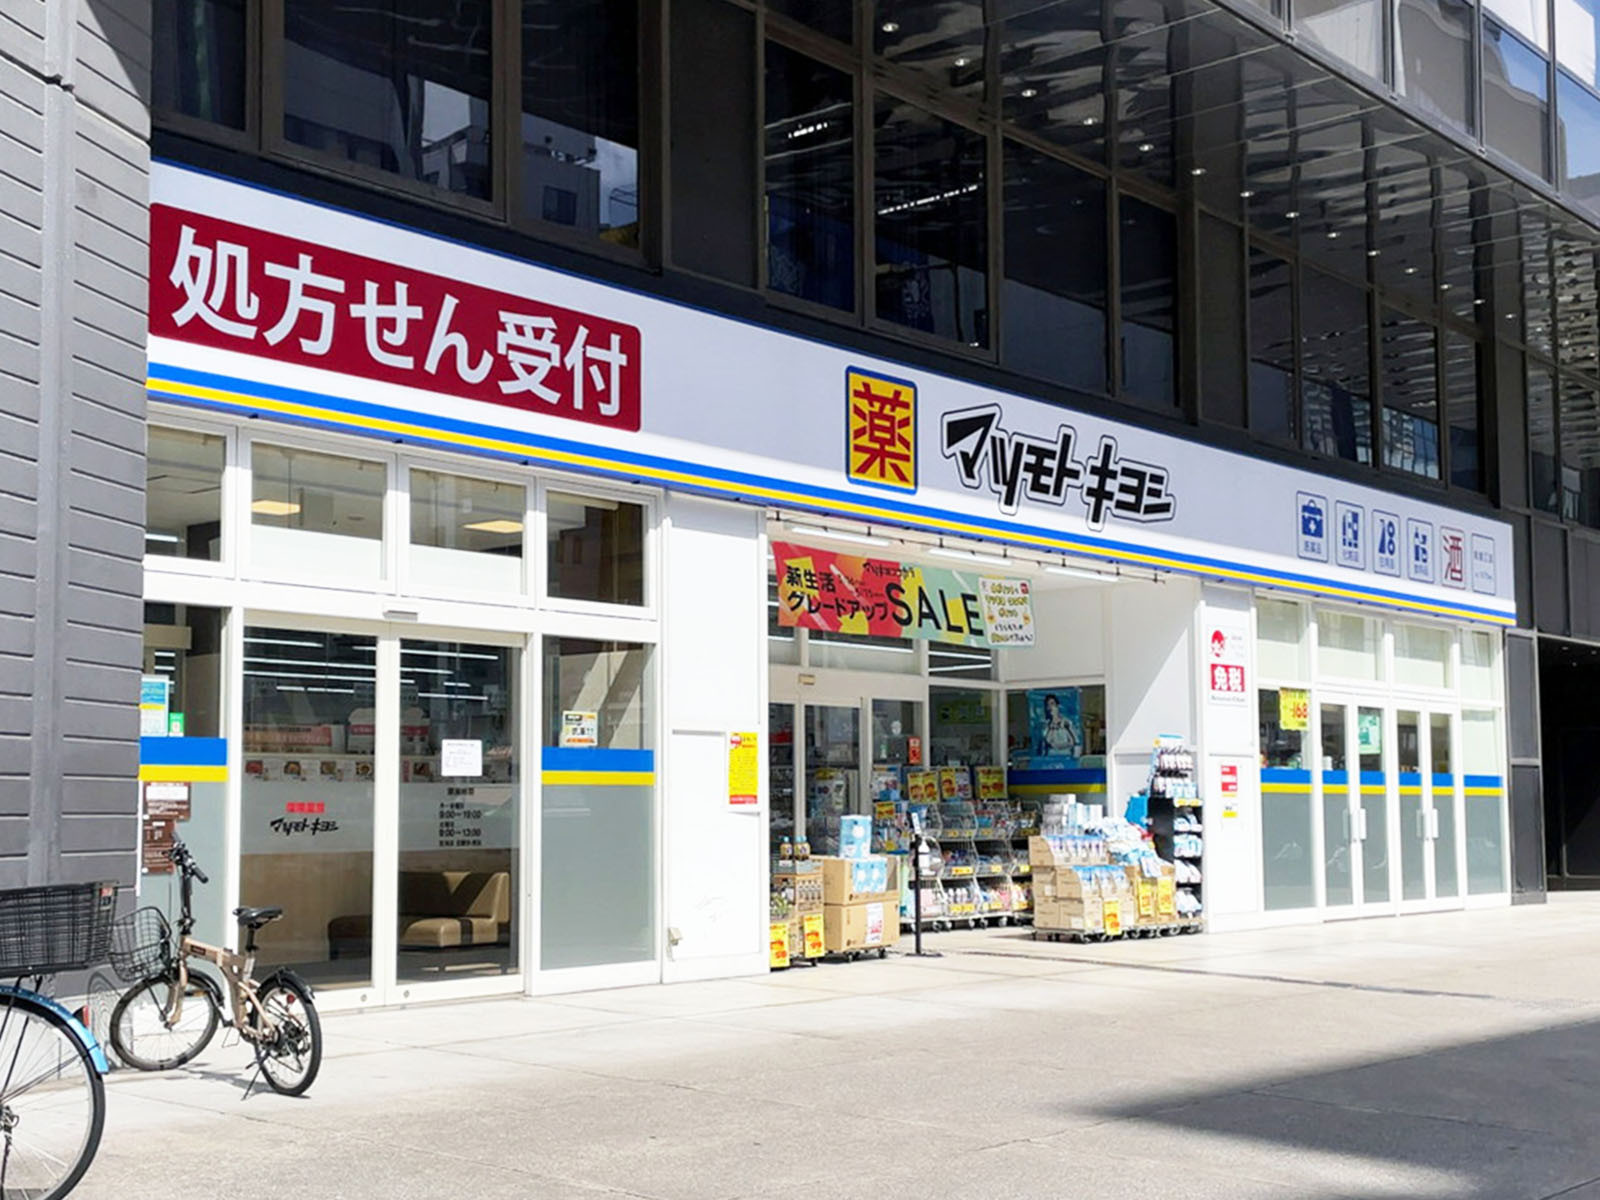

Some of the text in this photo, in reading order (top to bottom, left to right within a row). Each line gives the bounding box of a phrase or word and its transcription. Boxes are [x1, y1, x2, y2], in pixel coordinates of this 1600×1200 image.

[169, 224, 628, 417] 処方せん受付
[852, 381, 911, 484] 薬
[944, 409, 1173, 526] マツモトキヨシ
[786, 565, 836, 593] 新生活
[1442, 535, 1463, 582] 酒
[787, 591, 889, 621] グレードアップ
[885, 581, 984, 637] SALE
